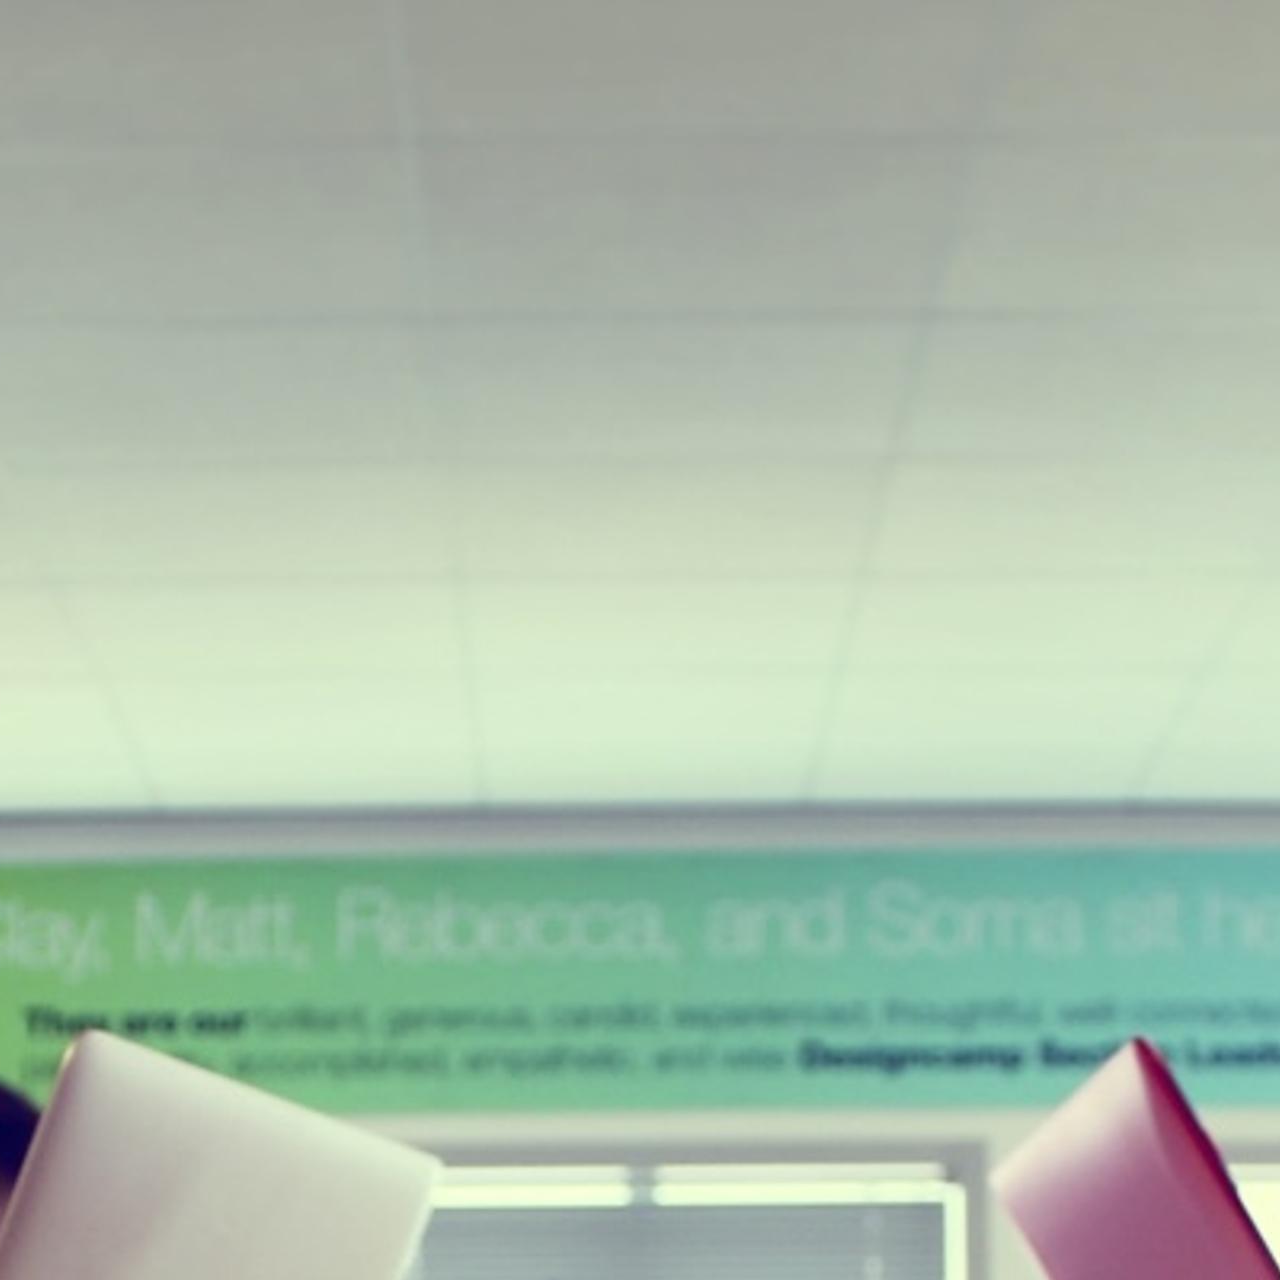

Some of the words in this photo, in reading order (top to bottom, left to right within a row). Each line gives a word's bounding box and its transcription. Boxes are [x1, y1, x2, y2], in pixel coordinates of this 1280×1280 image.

[131, 891, 313, 972] Matt,
[334, 884, 682, 966] Rebecca,
[702, 882, 845, 960] and
[866, 877, 1084, 960] Soma
[1104, 884, 1184, 957] sit
[124, 1010, 176, 1034] are
[192, 1010, 244, 1034] our
